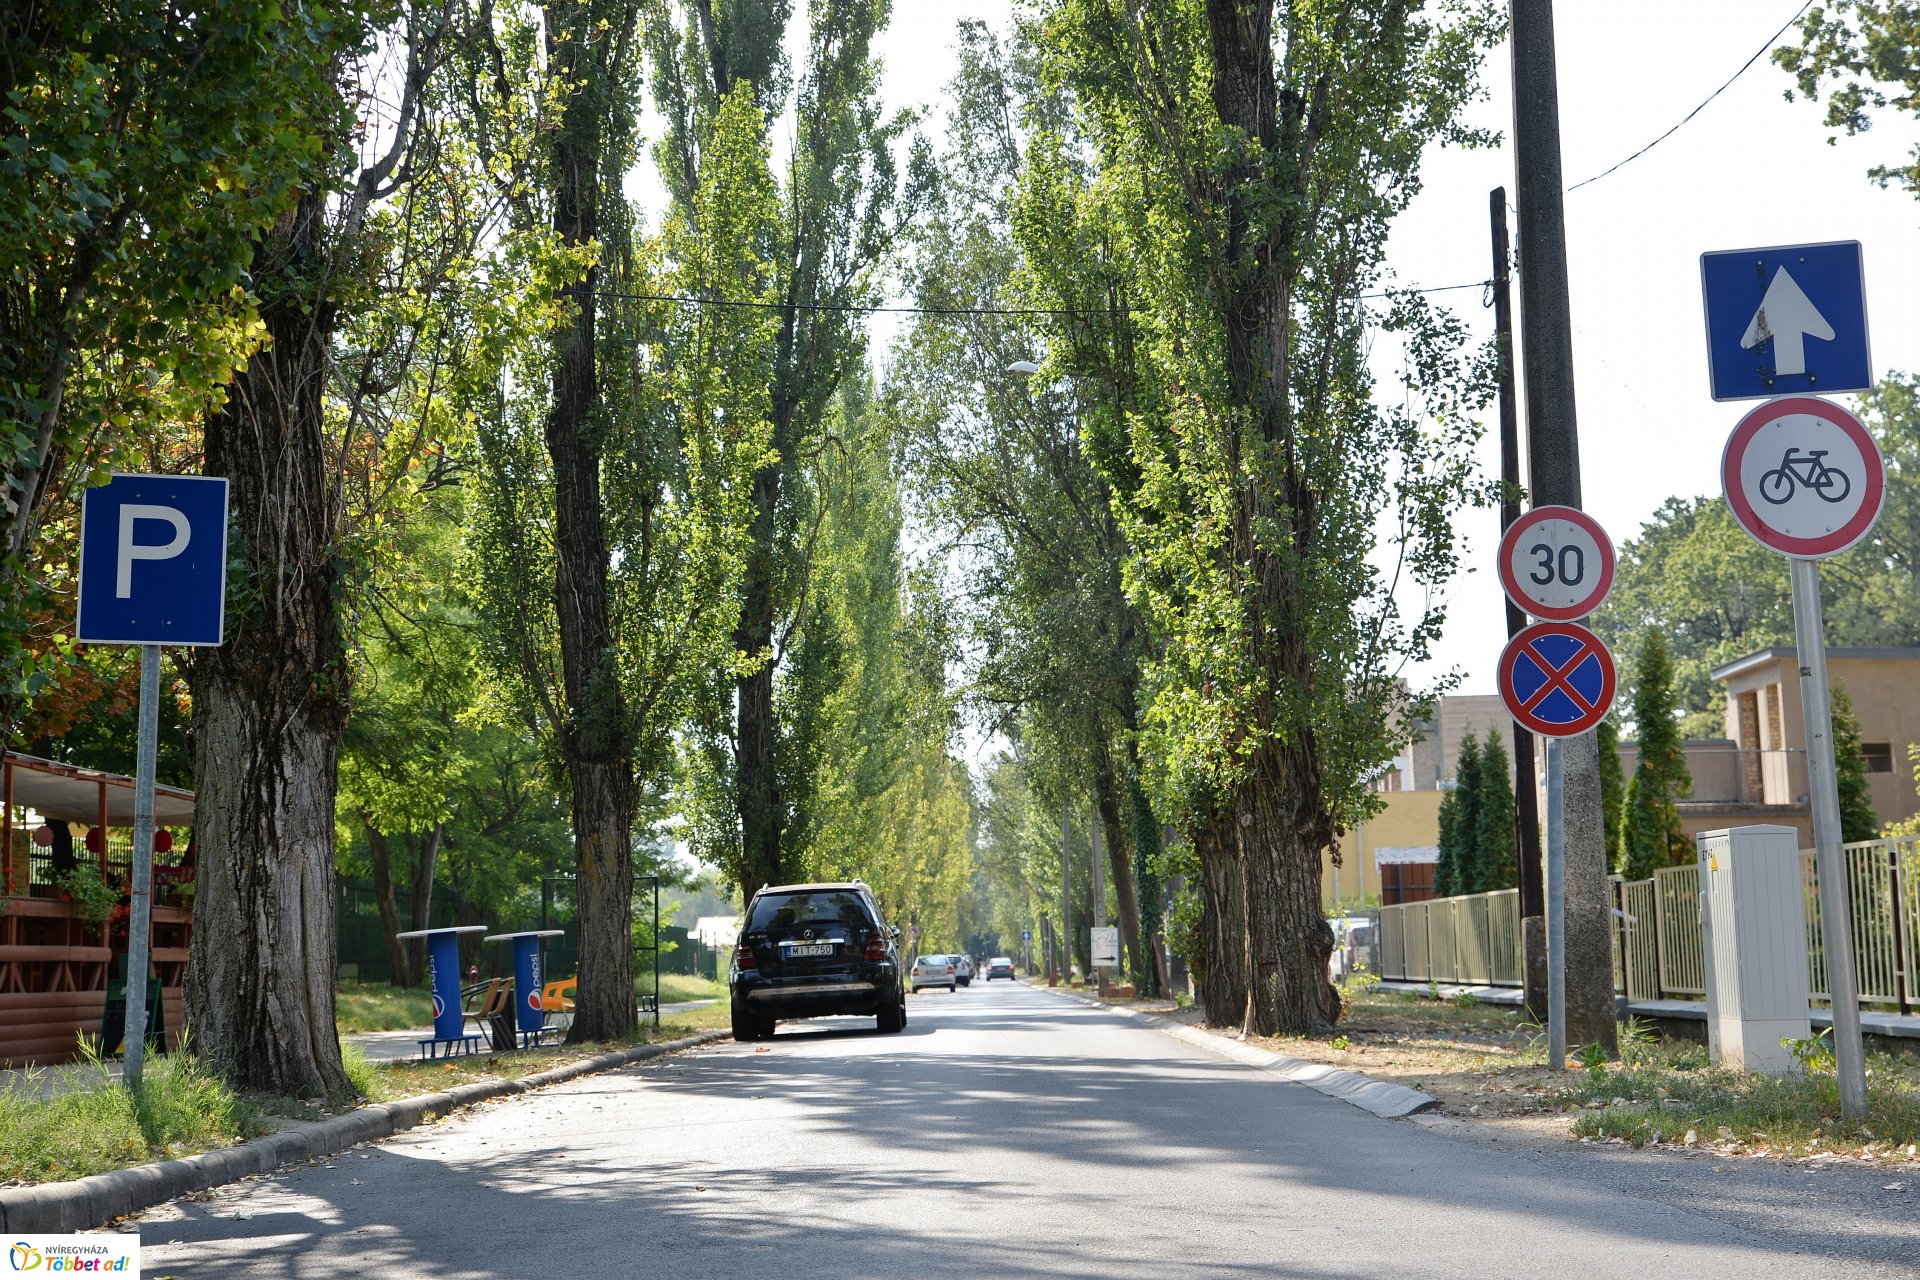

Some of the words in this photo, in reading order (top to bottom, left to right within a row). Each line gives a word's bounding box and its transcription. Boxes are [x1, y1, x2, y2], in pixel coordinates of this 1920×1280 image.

[116, 504, 191, 598] P
[1530, 543, 1583, 586] 30
[792, 945, 831, 956] MIT-750
[529, 953, 541, 987] pepsi
